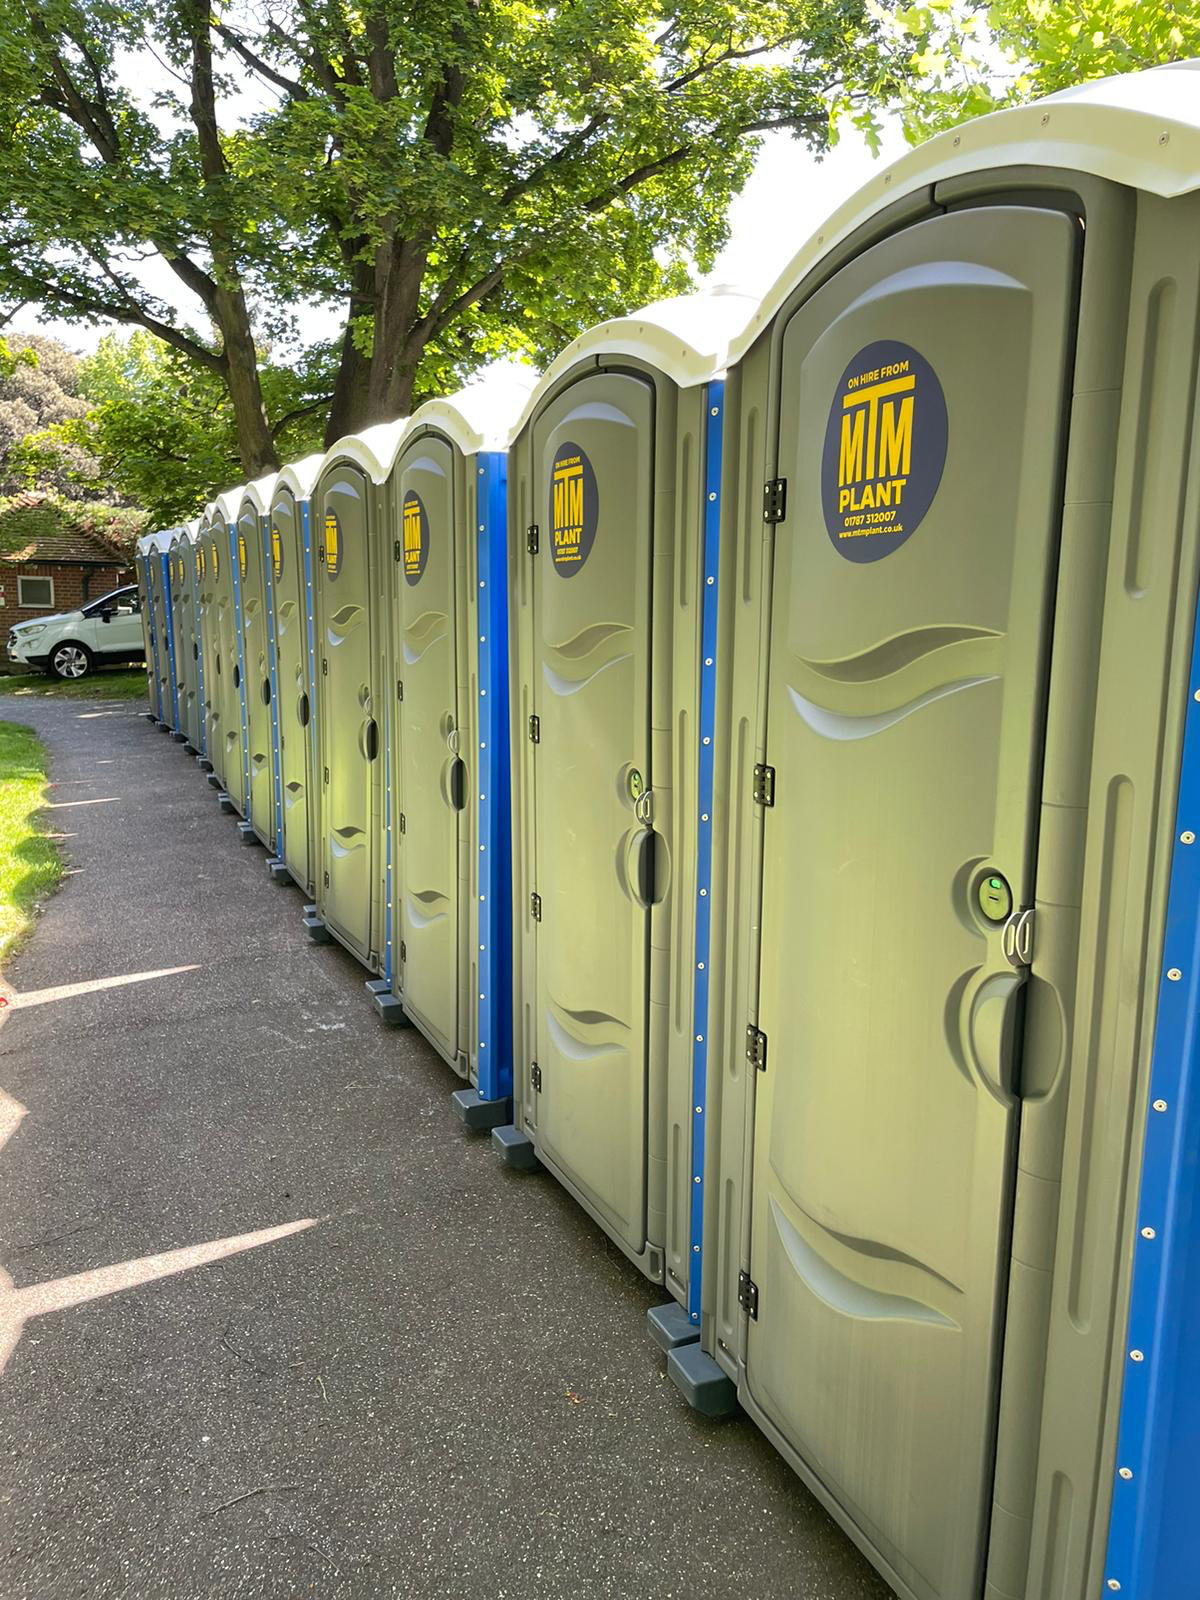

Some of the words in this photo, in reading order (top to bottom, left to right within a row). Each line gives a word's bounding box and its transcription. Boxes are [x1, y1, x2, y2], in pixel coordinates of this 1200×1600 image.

[848, 375, 859, 389] ON
[860, 370, 880, 386] HIRE
[881, 360, 909, 378] FROM
[838, 374, 916, 488] MTM
[554, 465, 583, 529] MTM
[838, 479, 906, 513] PLANT
[839, 523, 903, 539] www.mtmplant.co.uk
[844, 514, 865, 527] 01787
[865, 510, 896, 524] 312007
[555, 528, 582, 546] PLANT
